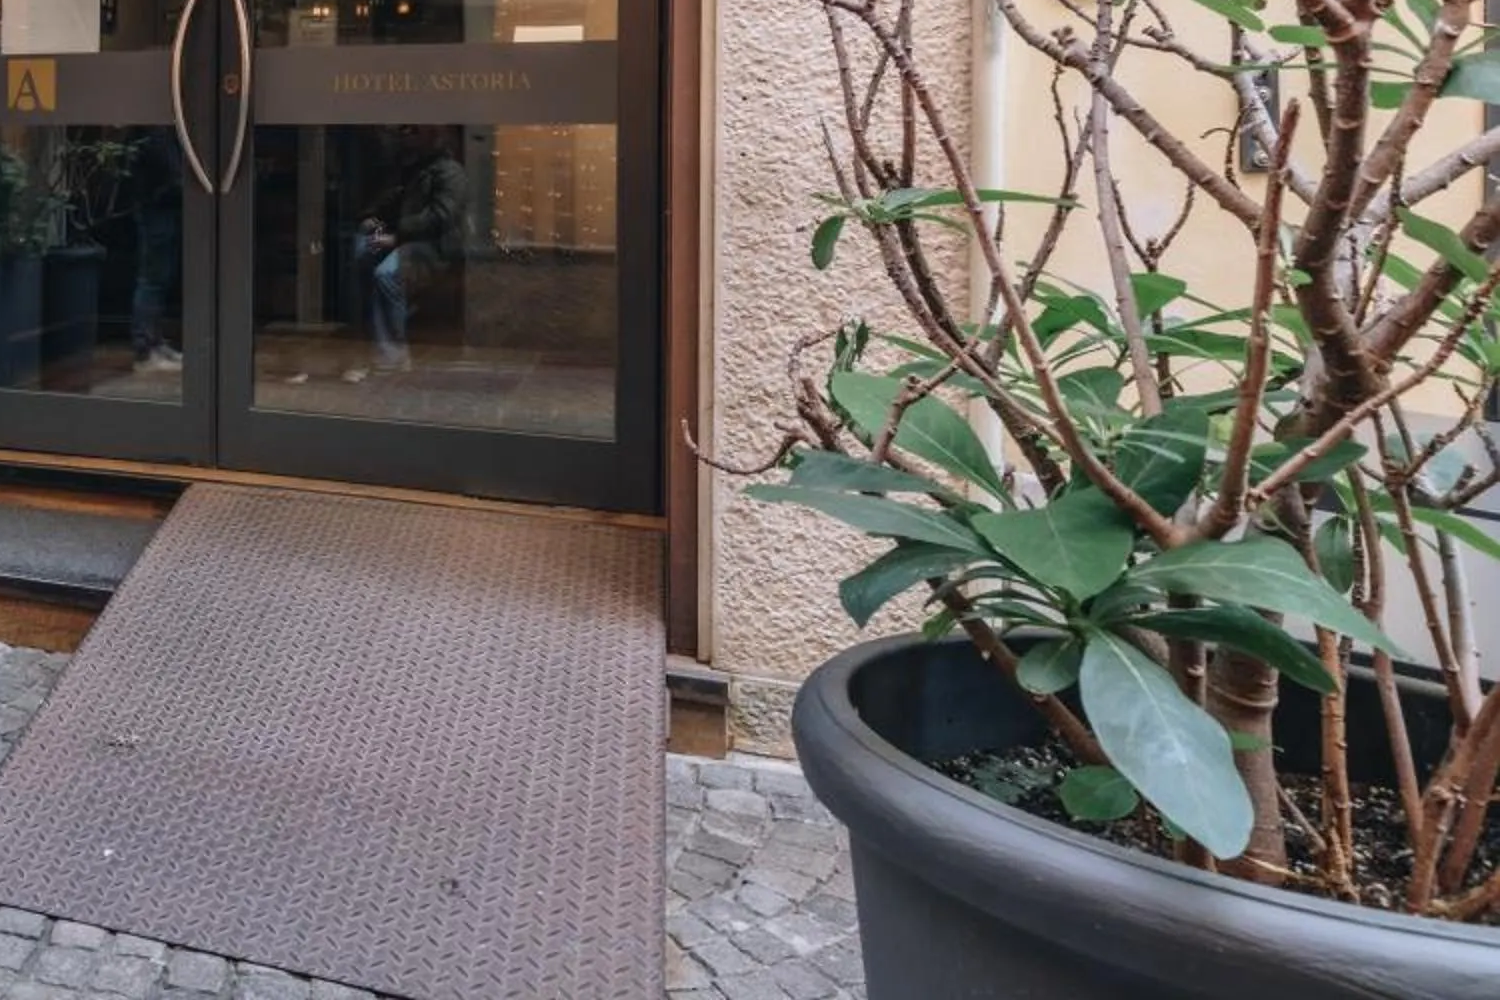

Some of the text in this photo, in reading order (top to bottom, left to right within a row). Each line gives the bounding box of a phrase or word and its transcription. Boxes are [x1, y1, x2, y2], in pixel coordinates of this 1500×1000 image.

[12, 67, 45, 110] A
[333, 69, 532, 94] HOTEL ASTORIA
